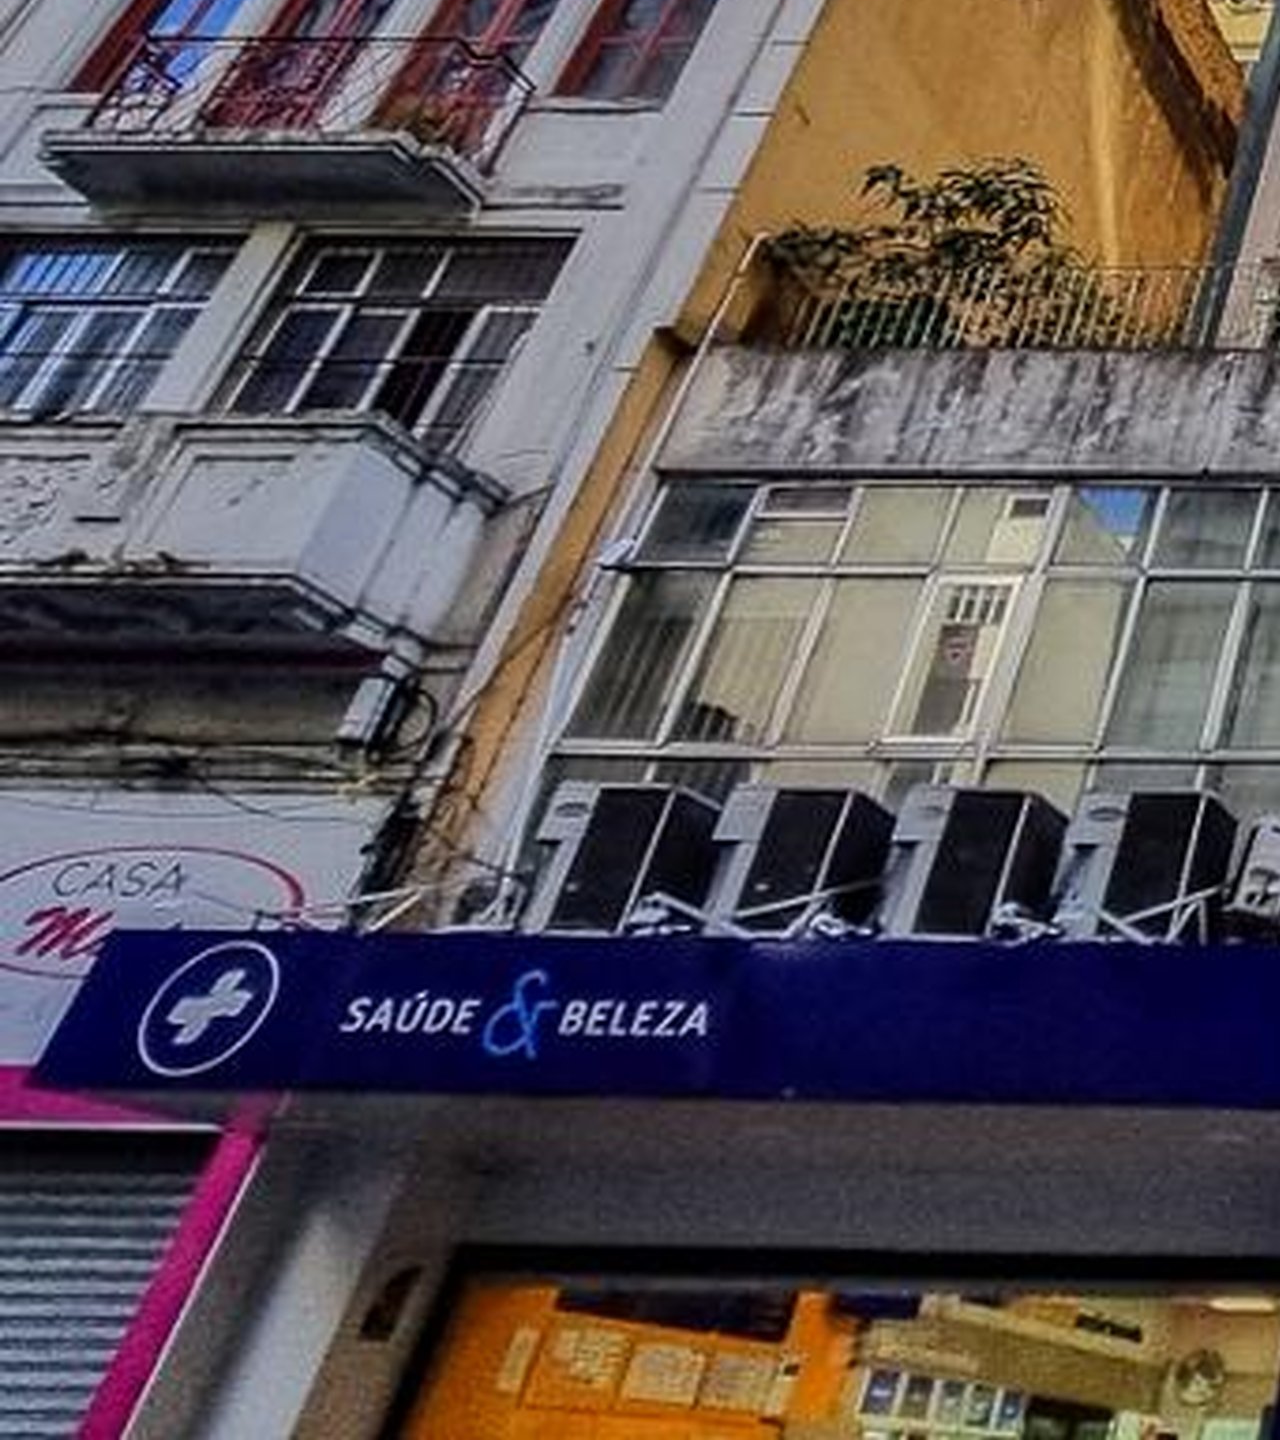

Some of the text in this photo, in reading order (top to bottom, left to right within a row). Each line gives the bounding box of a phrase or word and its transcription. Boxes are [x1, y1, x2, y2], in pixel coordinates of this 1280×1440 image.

[52, 861, 187, 898] CASA
[339, 970, 708, 1058] SAÚDE & BELEZA
